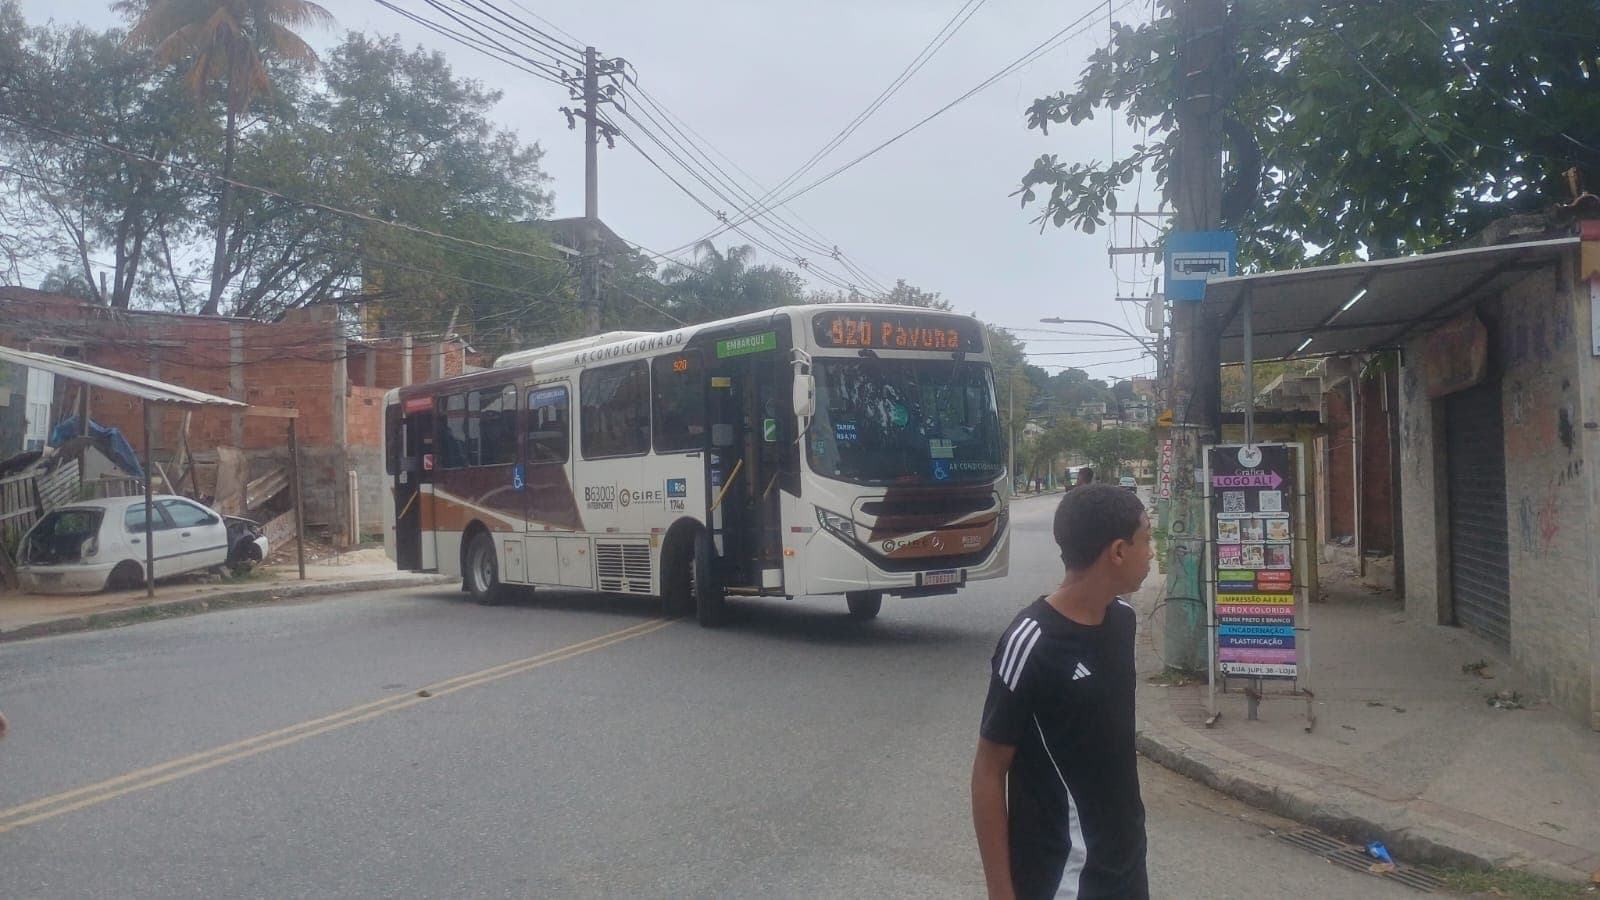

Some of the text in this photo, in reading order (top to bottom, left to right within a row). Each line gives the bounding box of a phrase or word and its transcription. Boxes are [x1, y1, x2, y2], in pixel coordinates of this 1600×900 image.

[832, 320, 959, 349] 920 Pavuna
[672, 360, 688, 372] 920
[949, 463, 958, 472] AR
[1216, 476, 1250, 486] LOGO
[674, 482, 685, 492] Rio
[584, 486, 616, 502] B63003
[632, 490, 662, 500] GIRE
[670, 500, 684, 510] 1746
[1222, 595, 1260, 603] IMPRESSÃO
[1222, 606, 1248, 614] XEROX
[1228, 626, 1284, 635] ENCADERNAÇÃO
[1230, 638, 1283, 646] PLASTIFICAÇÃO
